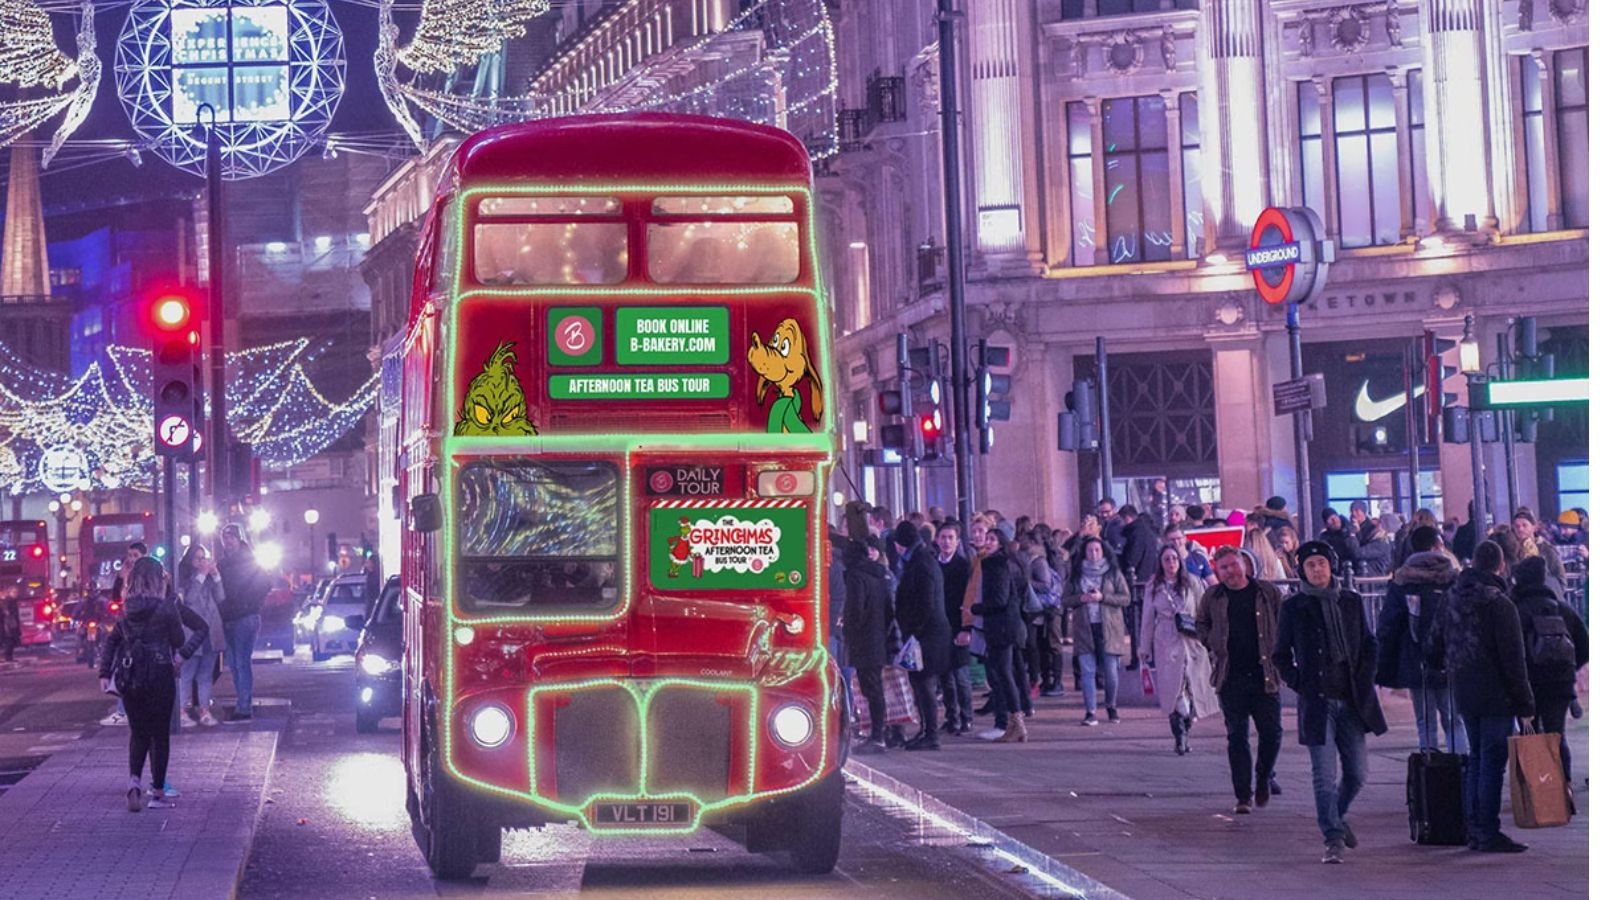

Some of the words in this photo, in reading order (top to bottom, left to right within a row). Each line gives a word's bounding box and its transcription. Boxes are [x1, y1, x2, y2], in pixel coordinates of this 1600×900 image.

[177, 48, 278, 61] CHRISTMAS
[235, 76, 273, 84] STREET
[1247, 246, 1299, 265] UNDERGROUND
[637, 319, 667, 334] BOOK
[670, 319, 709, 334] ONLINE
[630, 337, 716, 352] B-BAKERY.COM
[569, 379, 631, 393] AFTERNOON
[634, 378, 654, 393] TEA
[657, 378, 679, 393] BUS
[682, 378, 710, 393] TOUR
[677, 468, 721, 481] DAILY
[678, 482, 720, 495] TOUR
[690, 528, 773, 545] GRINCHMAS
[3, 550, 16, 561] 22
[705, 546, 757, 555] AFTERNOON
[759, 545, 774, 555] TEA
[729, 556, 747, 564] TOUR
[612, 806, 648, 821] VLT
[653, 806, 675, 821] 191
